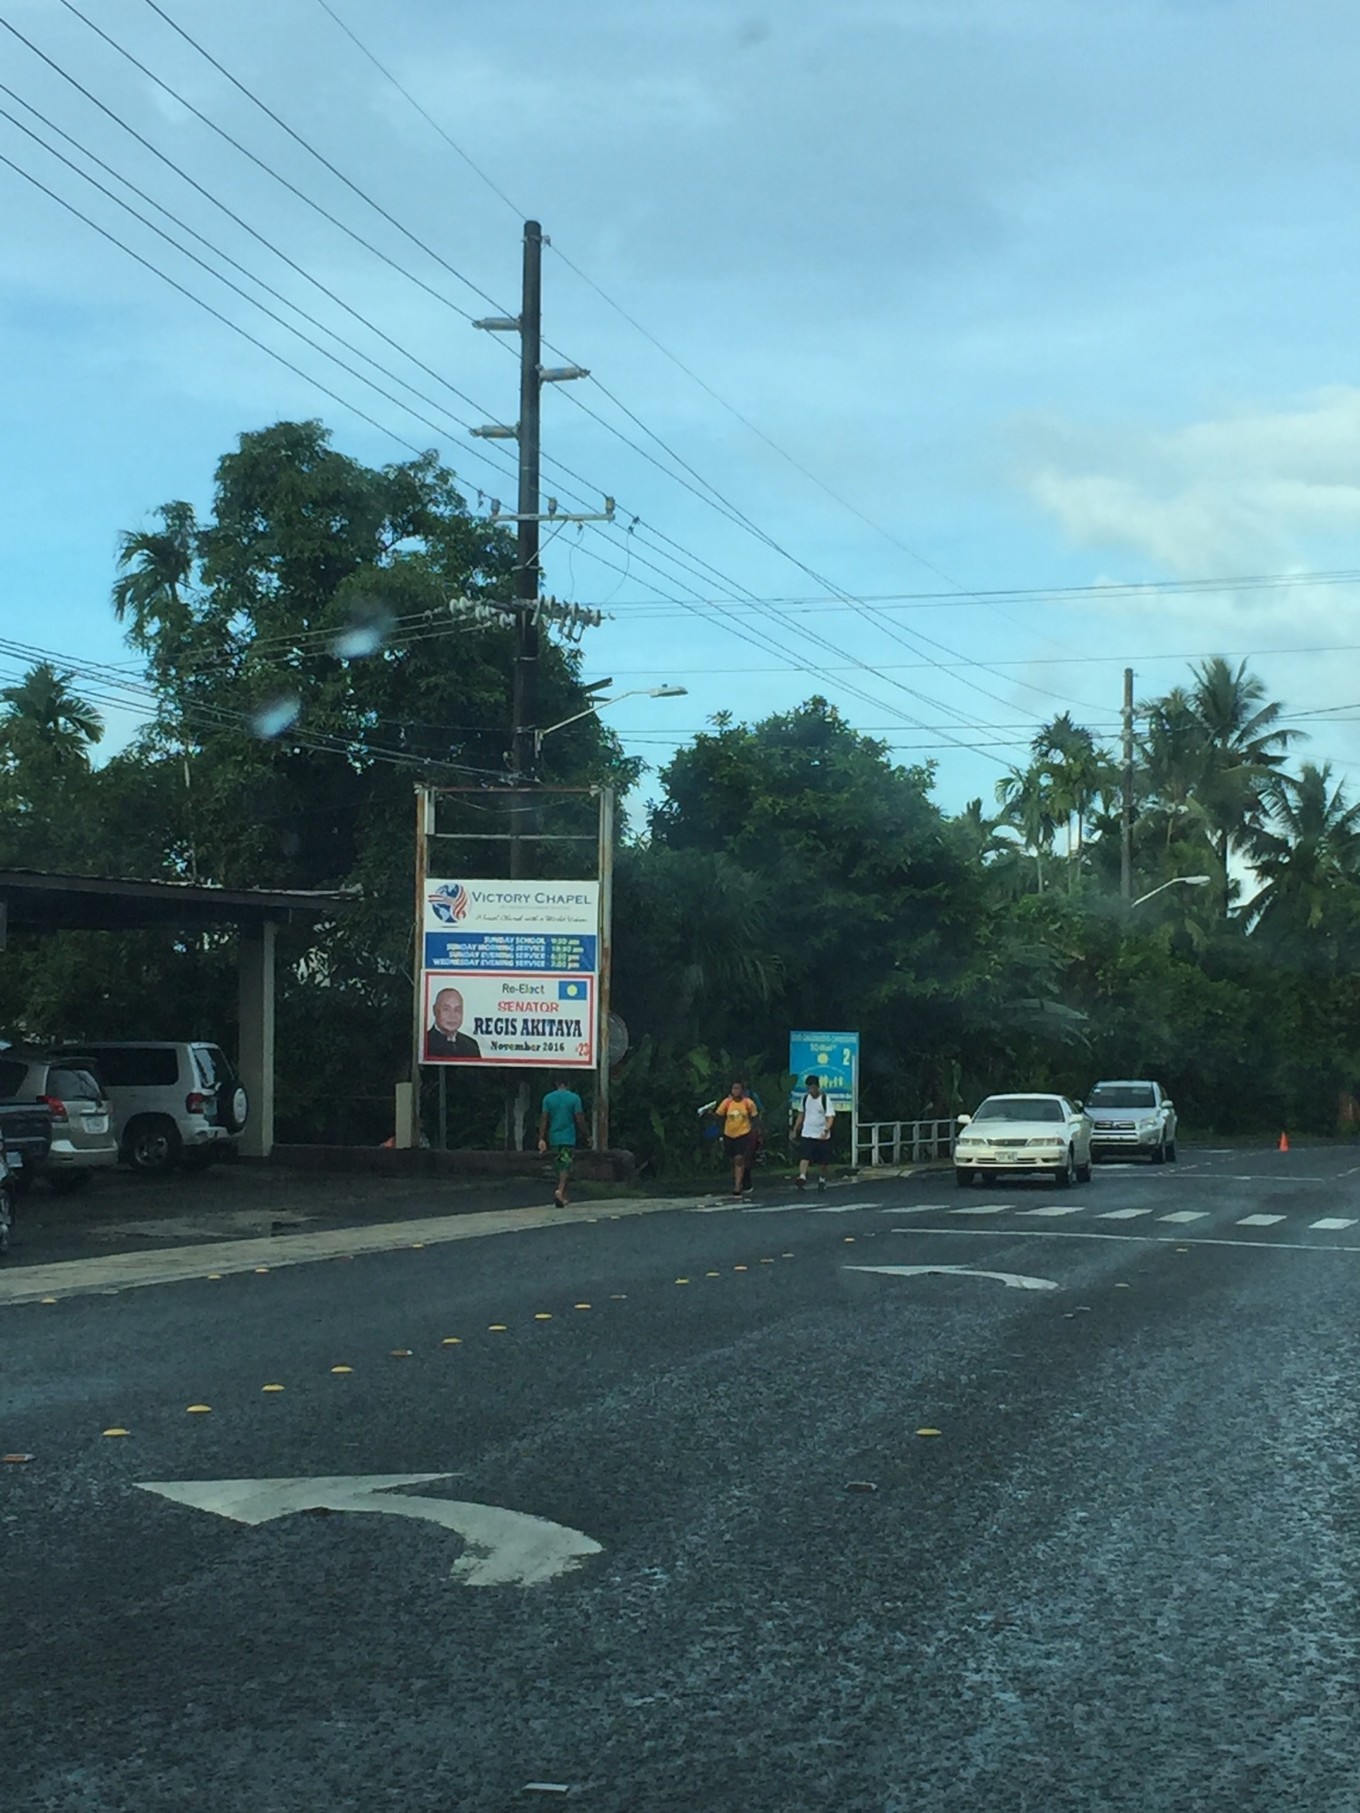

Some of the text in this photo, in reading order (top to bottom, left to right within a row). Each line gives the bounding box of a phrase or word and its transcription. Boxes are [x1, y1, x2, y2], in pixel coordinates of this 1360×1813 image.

[471, 891, 592, 905] VICTORY CHAPEL
[484, 936, 515, 944] SUNDAY
[446, 943, 477, 951] SUNDAY
[478, 943, 514, 951] MORNING
[432, 958, 479, 966] WEDNESDAY
[515, 959, 546, 967] SERVICE
[502, 983, 545, 995] Re-Elect
[497, 1001, 560, 1013] SENATOR
[473, 1017, 582, 1038] REGIS AKITAYA
[490, 1041, 565, 1052] November 2016
[843, 1048, 851, 1066] 2
